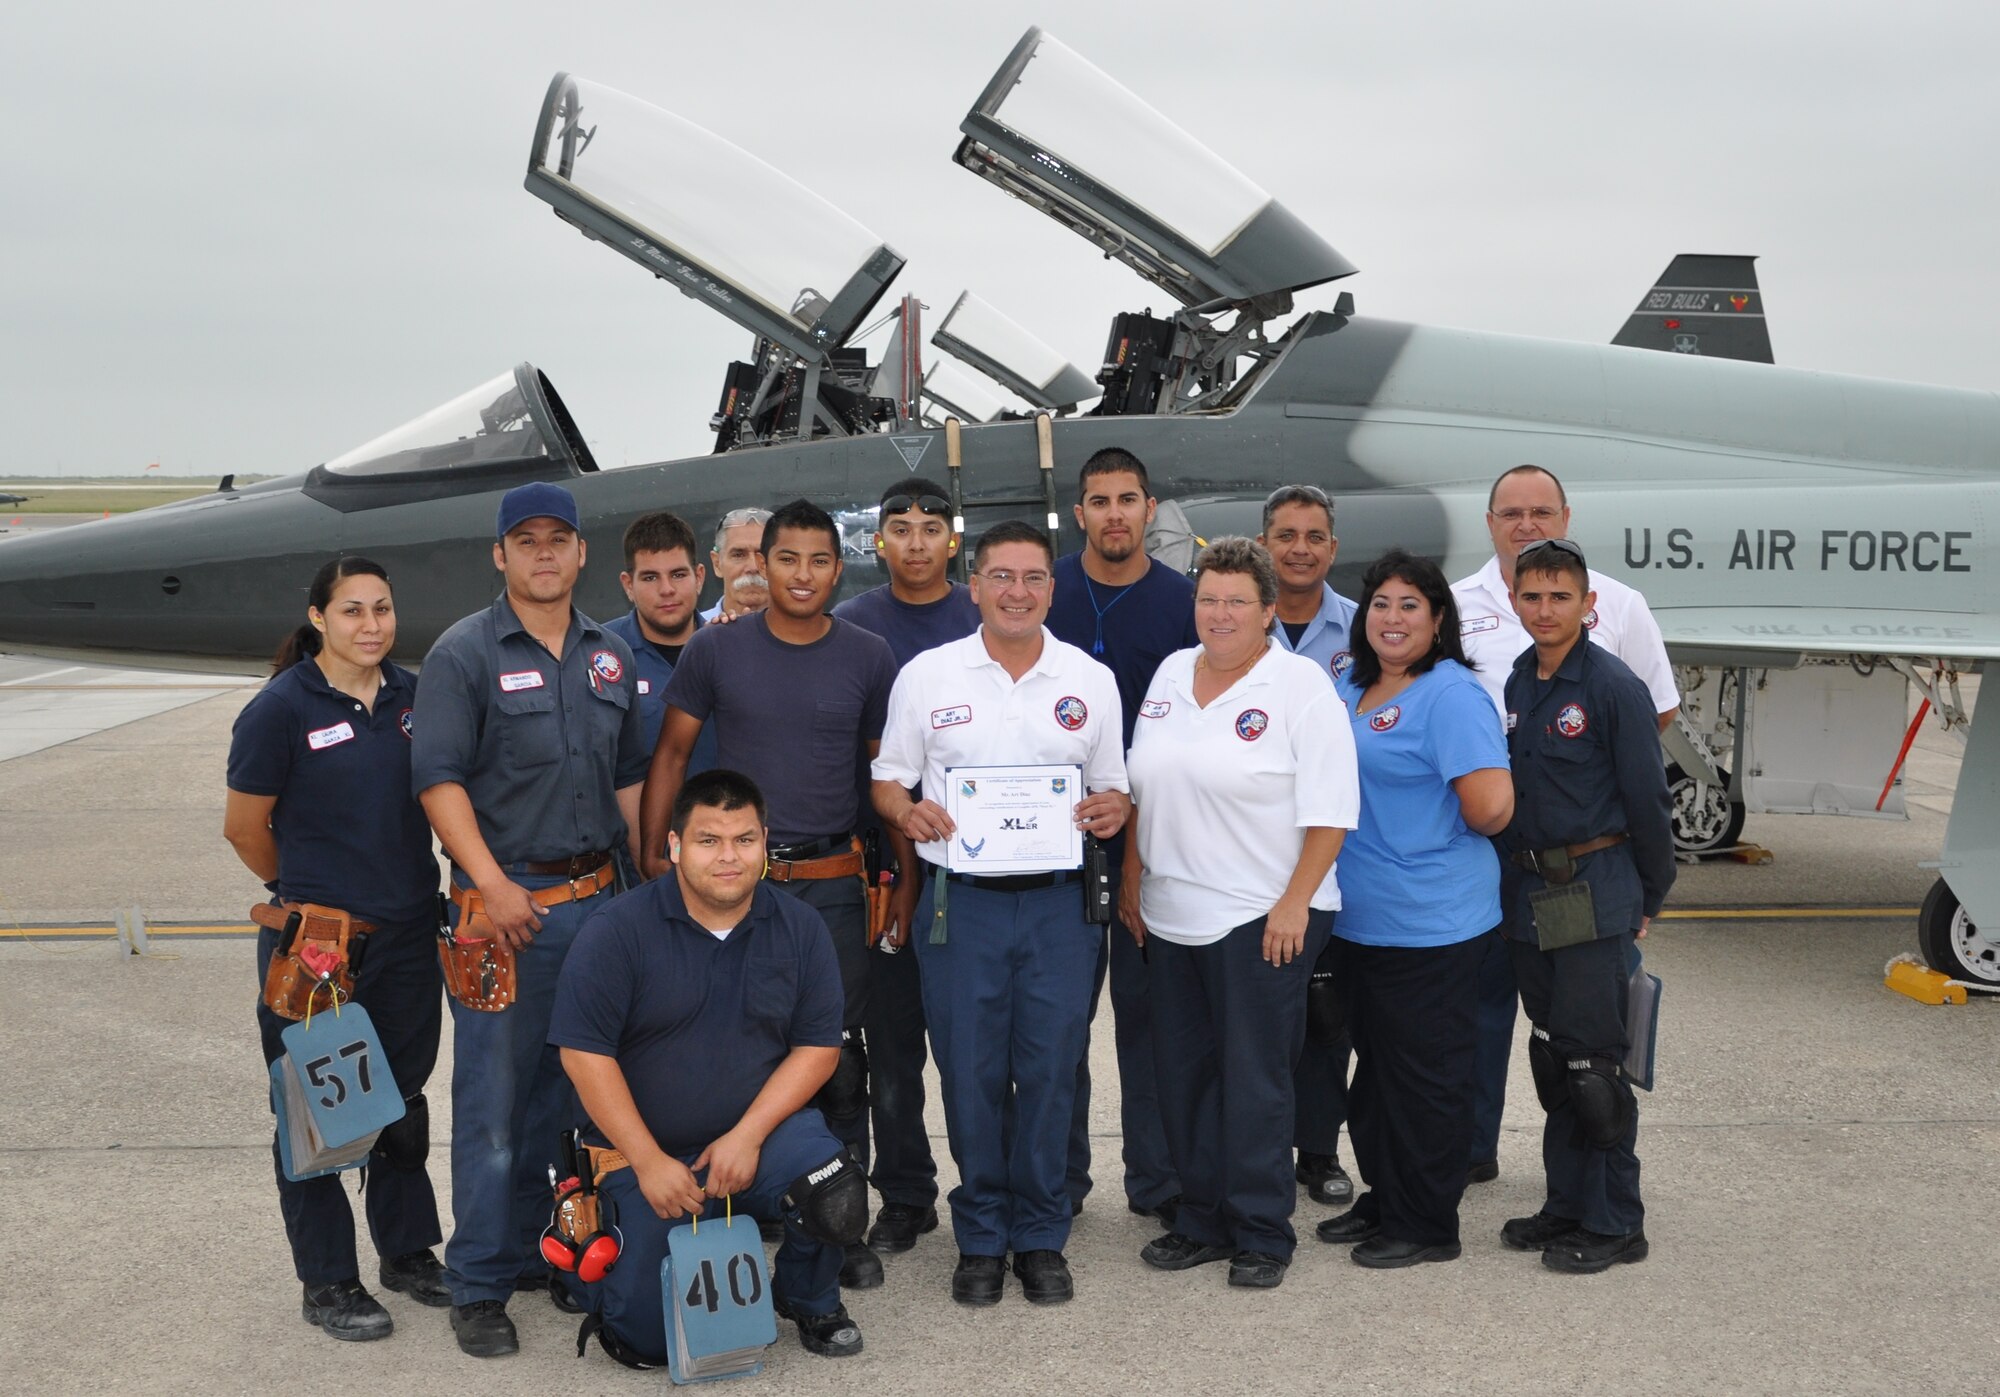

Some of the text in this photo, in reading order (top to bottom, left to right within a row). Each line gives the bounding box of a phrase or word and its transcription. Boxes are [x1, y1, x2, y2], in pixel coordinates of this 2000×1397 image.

[646, 246, 669, 264] Marc
[1646, 293, 1710, 310] RED BULLS
[1624, 528, 1972, 572] U.S. AIR FORCE
[305, 1040, 373, 1109] 57
[807, 1158, 843, 1186] IRWIN
[685, 1253, 762, 1313] 40
